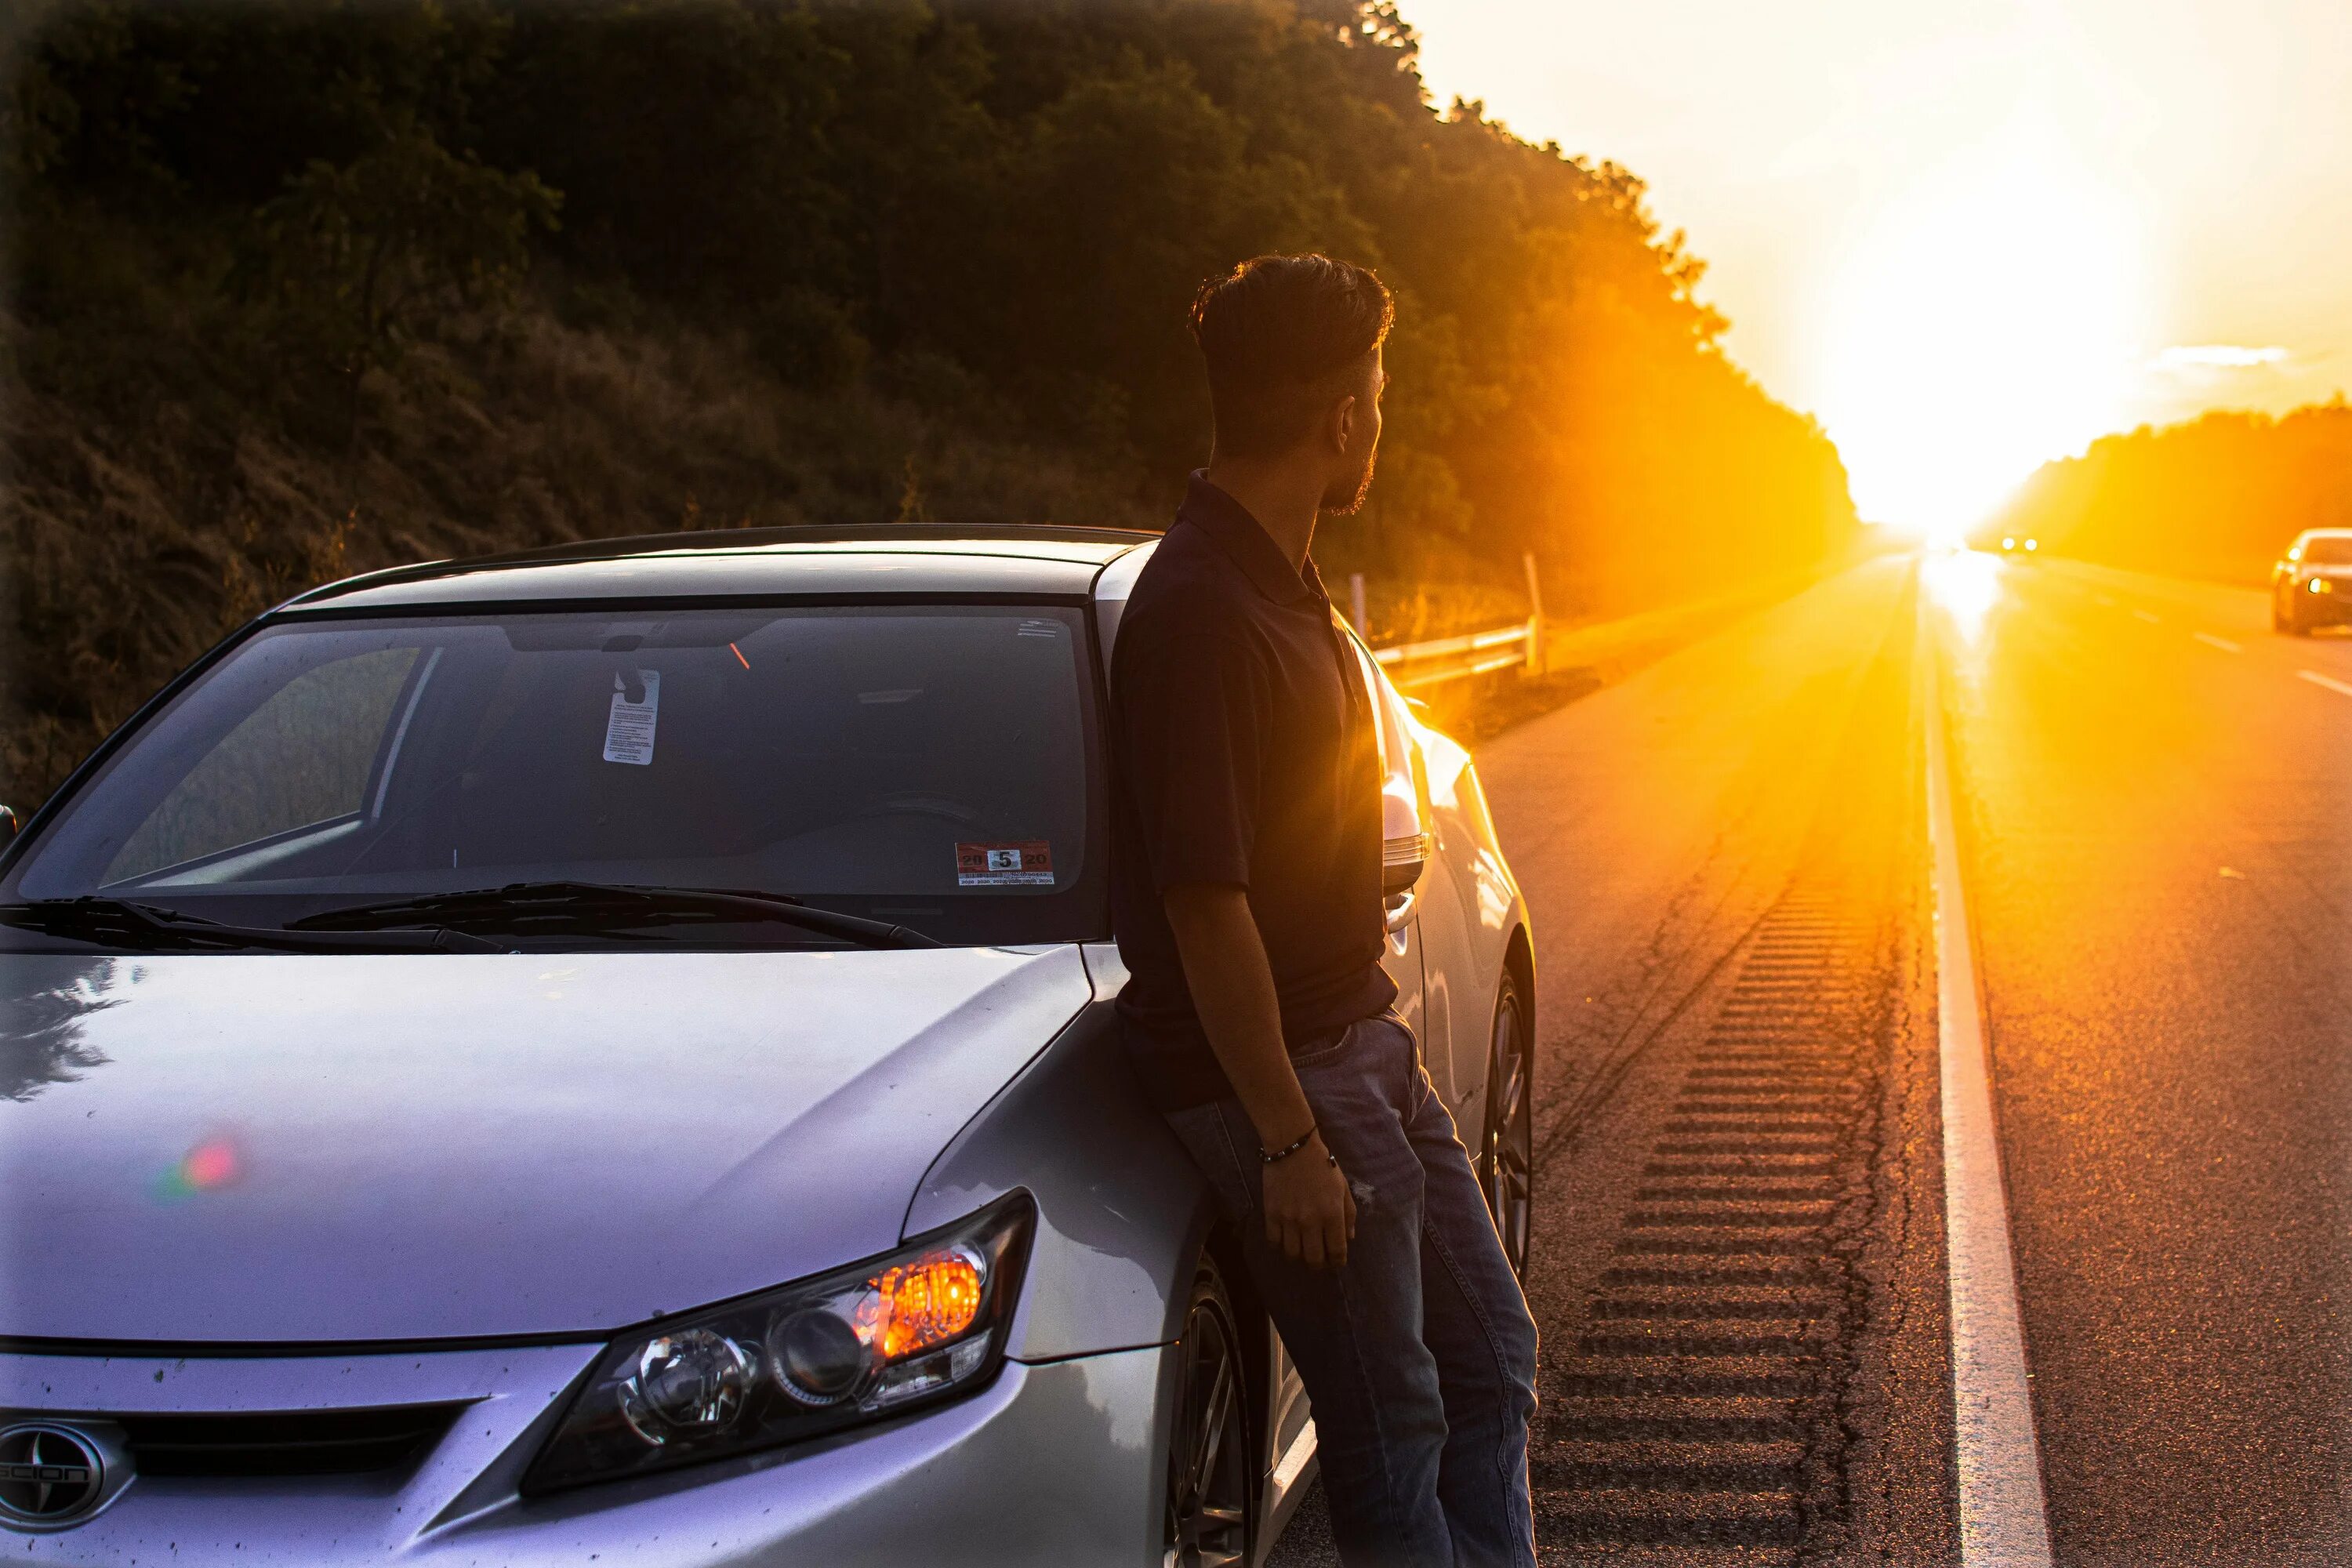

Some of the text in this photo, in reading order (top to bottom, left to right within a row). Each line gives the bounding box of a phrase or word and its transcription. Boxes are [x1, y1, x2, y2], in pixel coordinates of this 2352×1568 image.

[963, 851, 1047, 867] 20 5 20
